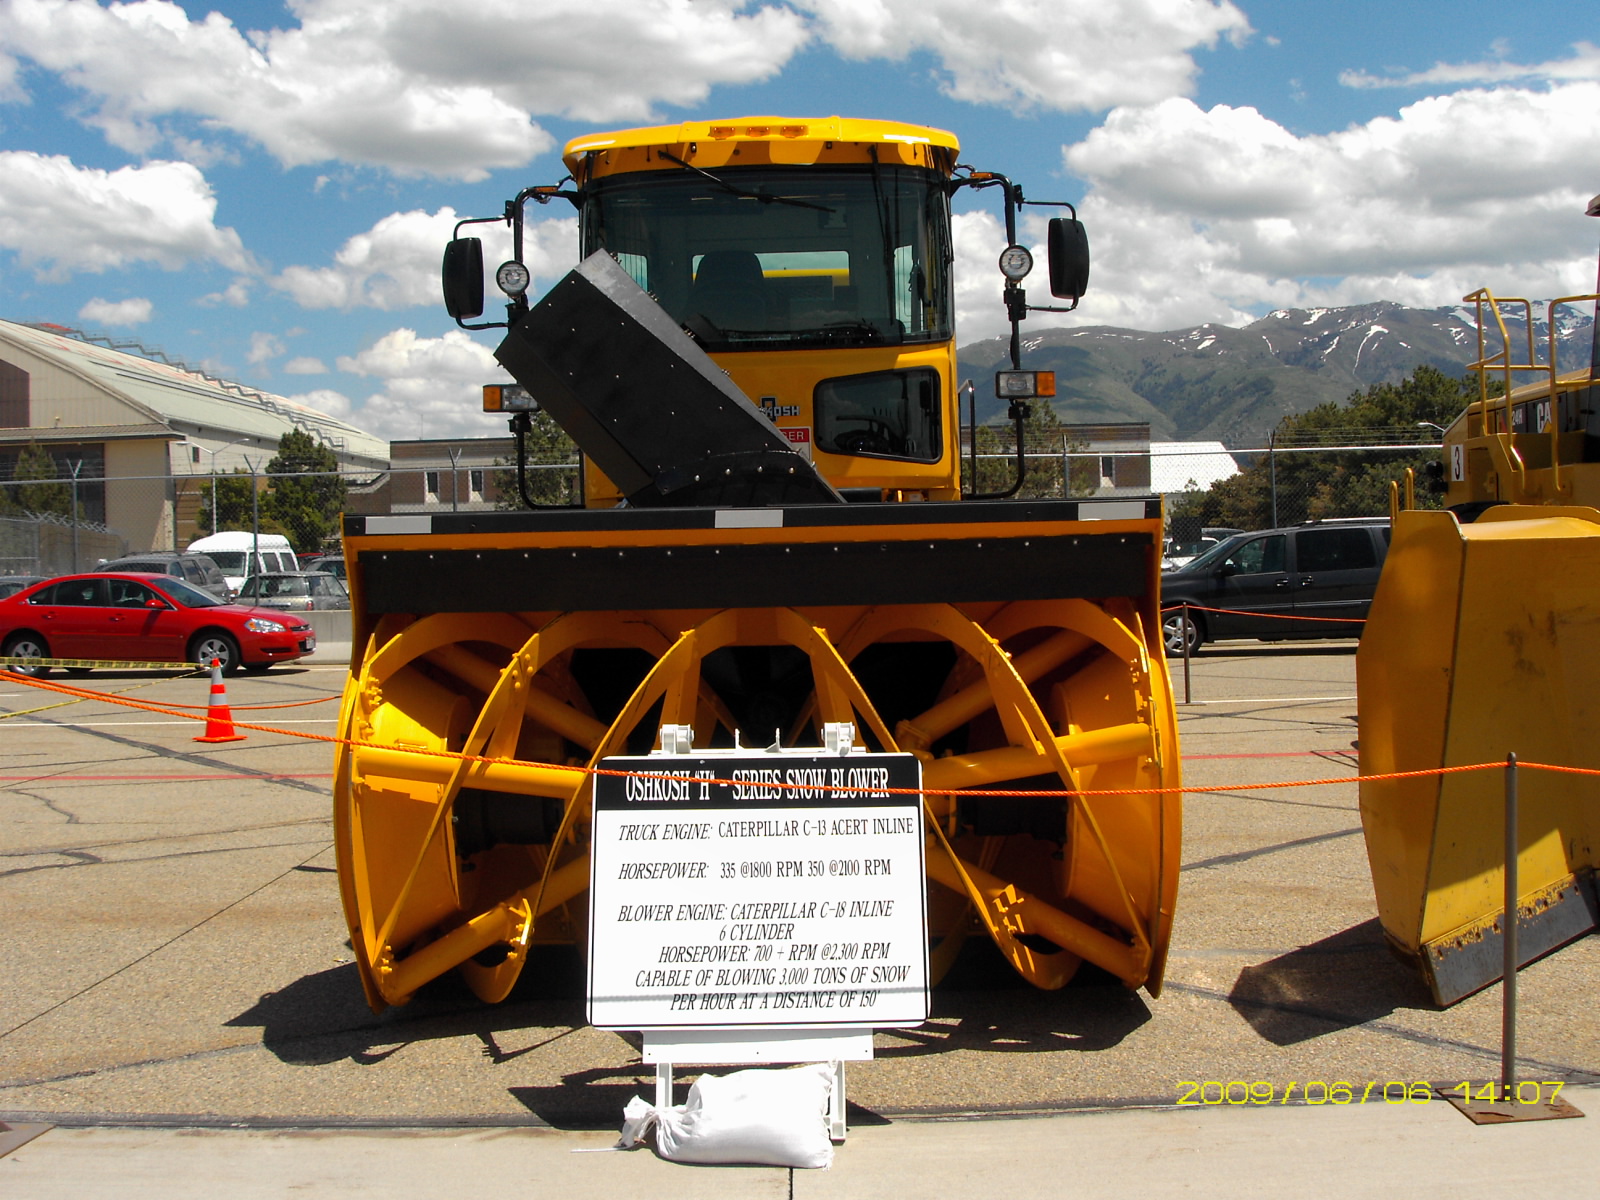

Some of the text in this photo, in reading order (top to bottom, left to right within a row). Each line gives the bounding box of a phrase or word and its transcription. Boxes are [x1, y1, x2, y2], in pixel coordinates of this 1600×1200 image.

[1454, 446, 1461, 480] 3
[625, 770, 690, 801] OSHKOSH
[732, 769, 782, 800] SERIES
[786, 768, 827, 799] SNOW
[831, 767, 890, 799] BLOWER
[618, 817, 914, 841] TRUCK ENGINE: CATERPILLAR C-13 ACERT INLINE
[618, 858, 892, 880] HORSEPOWER: 335 @1800 RPM 350 @2100 RPM
[617, 899, 895, 922] BLOWER ENGINE: CATERPILLAR C-18 INLINE
[719, 923, 795, 941] 6 CYLINDER
[658, 945, 751, 963] HORSEPOWER:
[753, 944, 773, 961] 700
[776, 946, 785, 960] +
[788, 943, 819, 961] RPM
[861, 942, 891, 960] RPM
[635, 965, 911, 987] CAPABLE OF BLOWING 3,000 TONS OF SNOW
[670, 989, 881, 1010] PER HOUR AT A DISTANCE OF 150'
